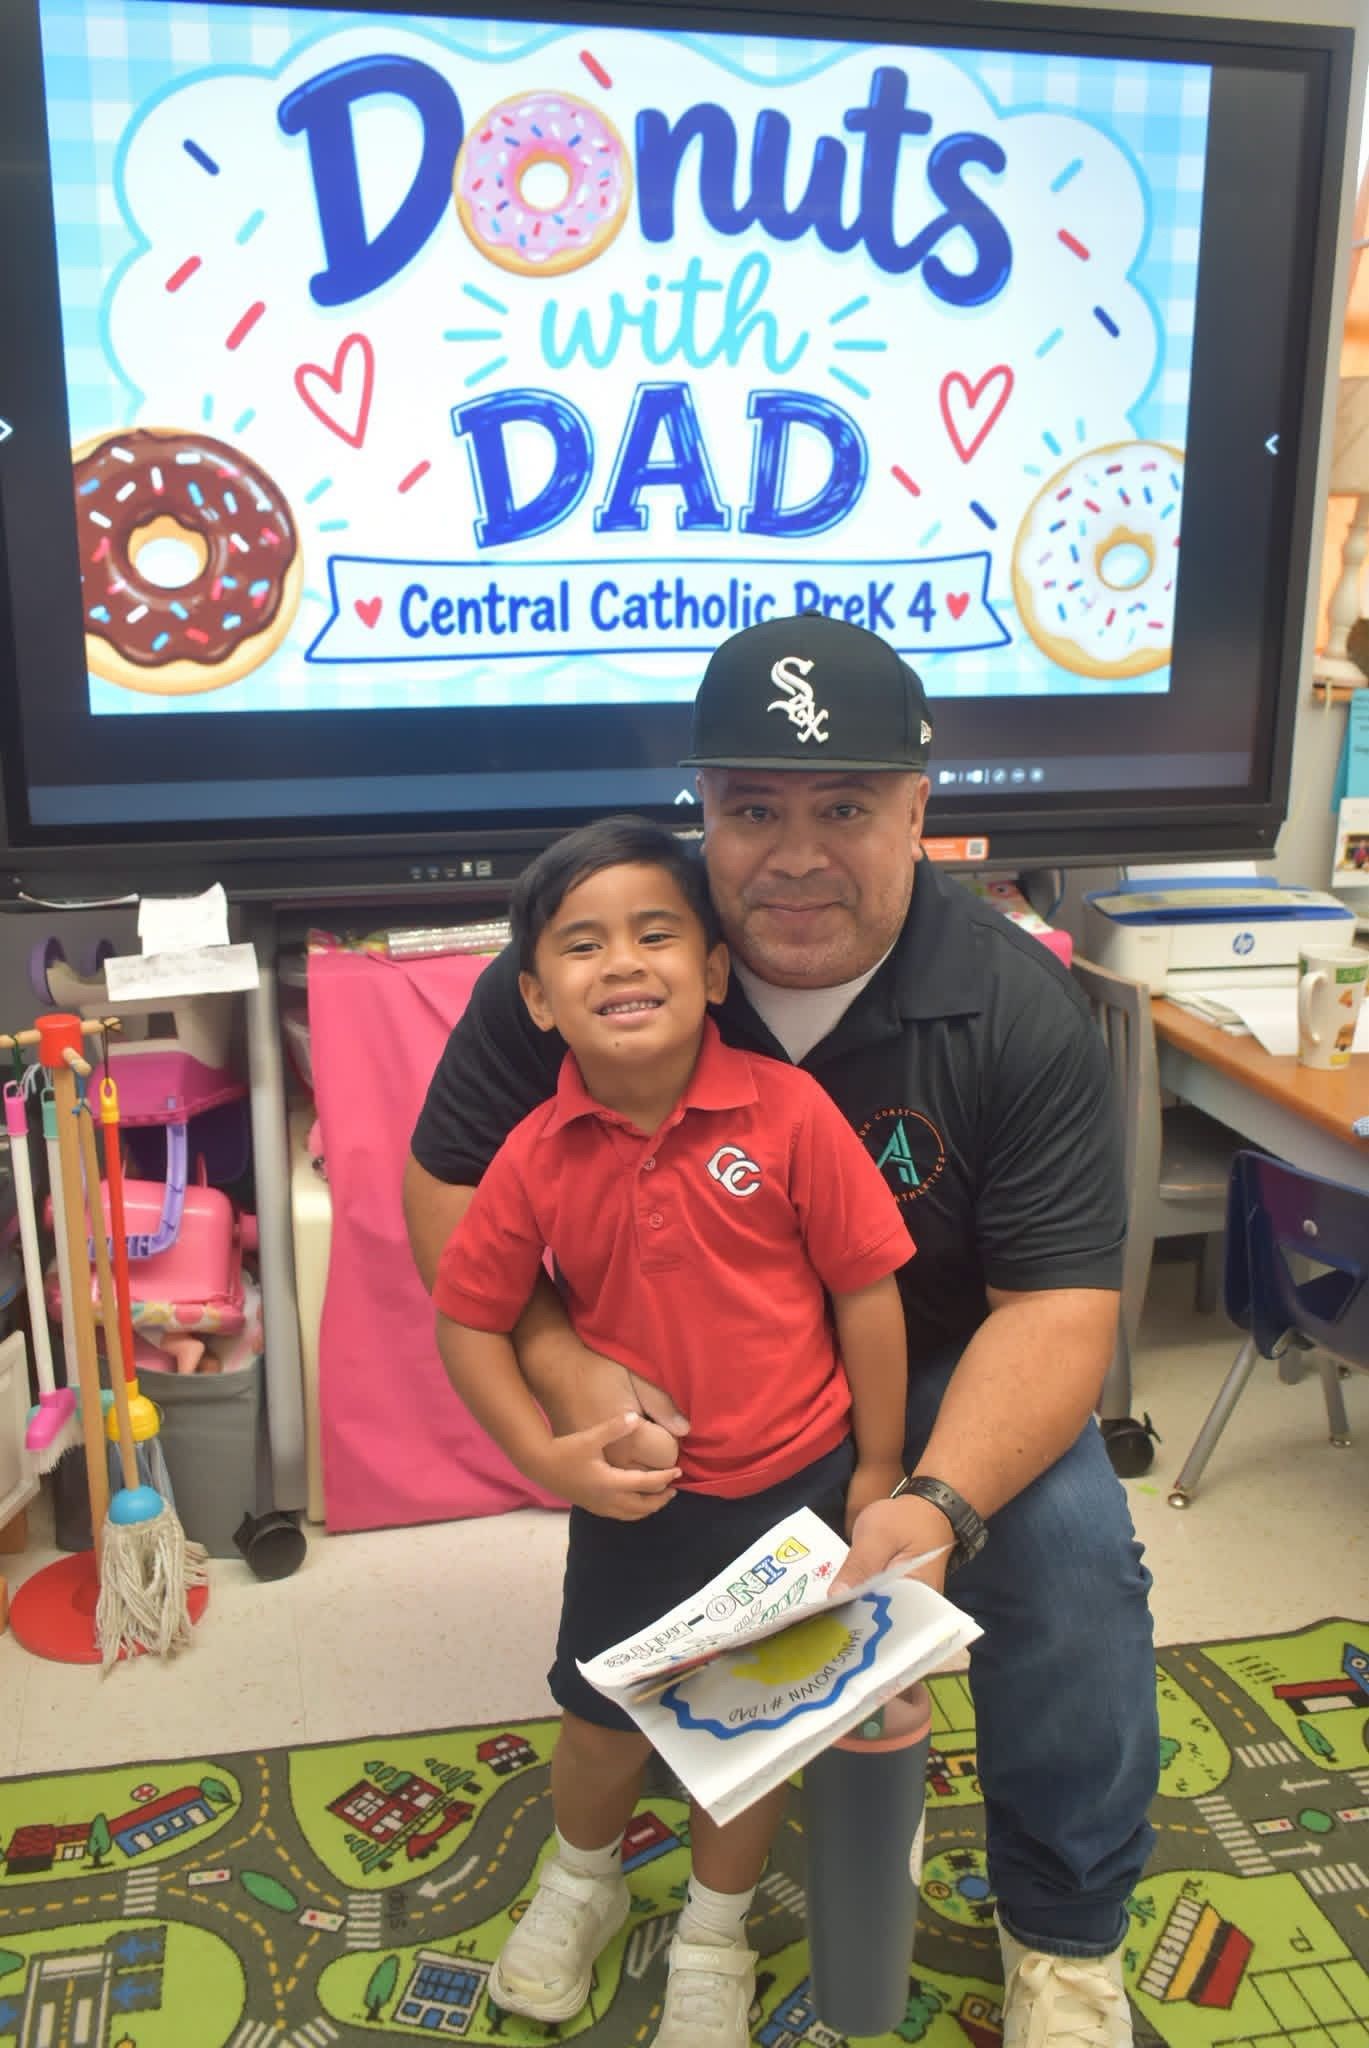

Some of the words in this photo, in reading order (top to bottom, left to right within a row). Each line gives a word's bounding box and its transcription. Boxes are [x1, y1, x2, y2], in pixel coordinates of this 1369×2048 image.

[539, 251, 810, 374] with
[450, 381, 869, 549] DAD
[399, 580, 570, 639] Central
[589, 577, 776, 631] Catholic
[794, 580, 896, 632] PreK
[907, 580, 937, 633] 4
[1232, 932, 1255, 955] hp
[874, 1107, 910, 1121] COAST
[705, 1145, 762, 1198] CC
[838, 1627, 863, 1665] HANDS
[788, 1664, 840, 1703] DOWN
[728, 1706, 758, 1723] DAD
